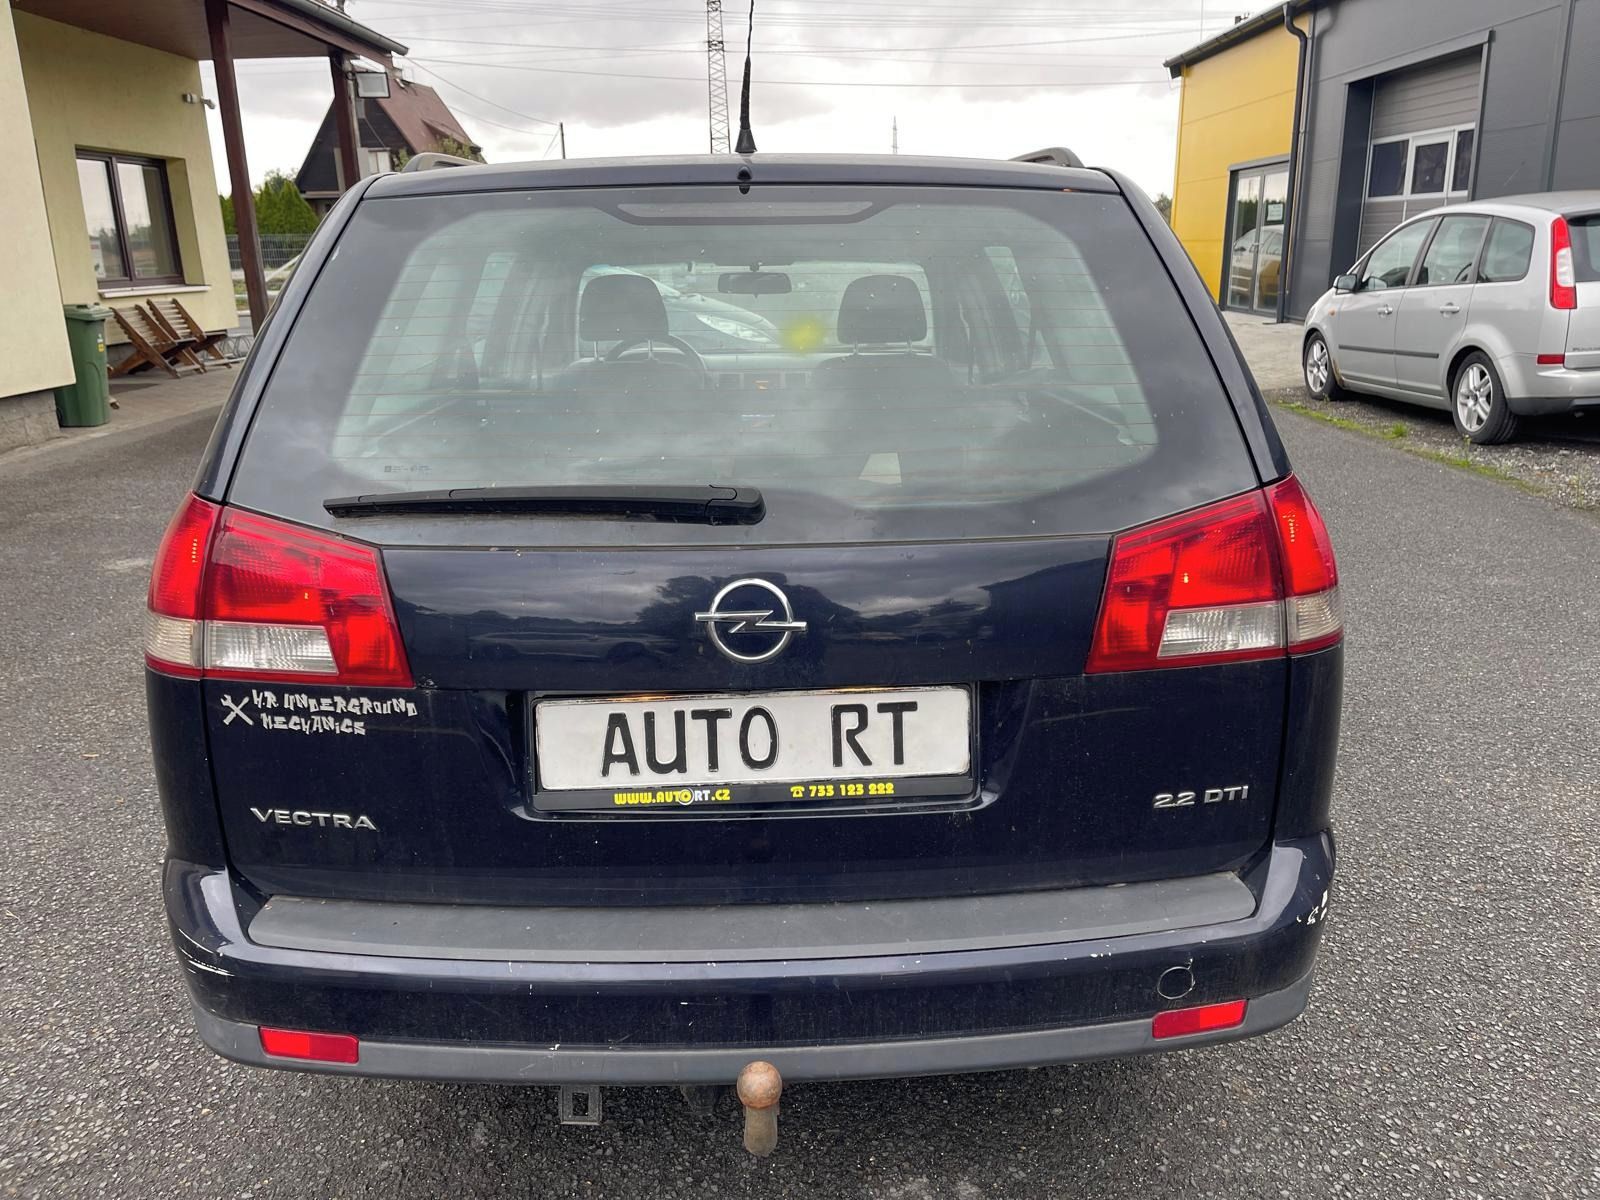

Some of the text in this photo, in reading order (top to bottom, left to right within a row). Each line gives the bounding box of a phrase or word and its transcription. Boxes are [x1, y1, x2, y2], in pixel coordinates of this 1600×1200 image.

[284, 693, 418, 717] UNDERGROUND
[601, 701, 918, 777] AUTO RT
[808, 782, 895, 798] 733 123 222
[250, 807, 378, 832] VECTRA
